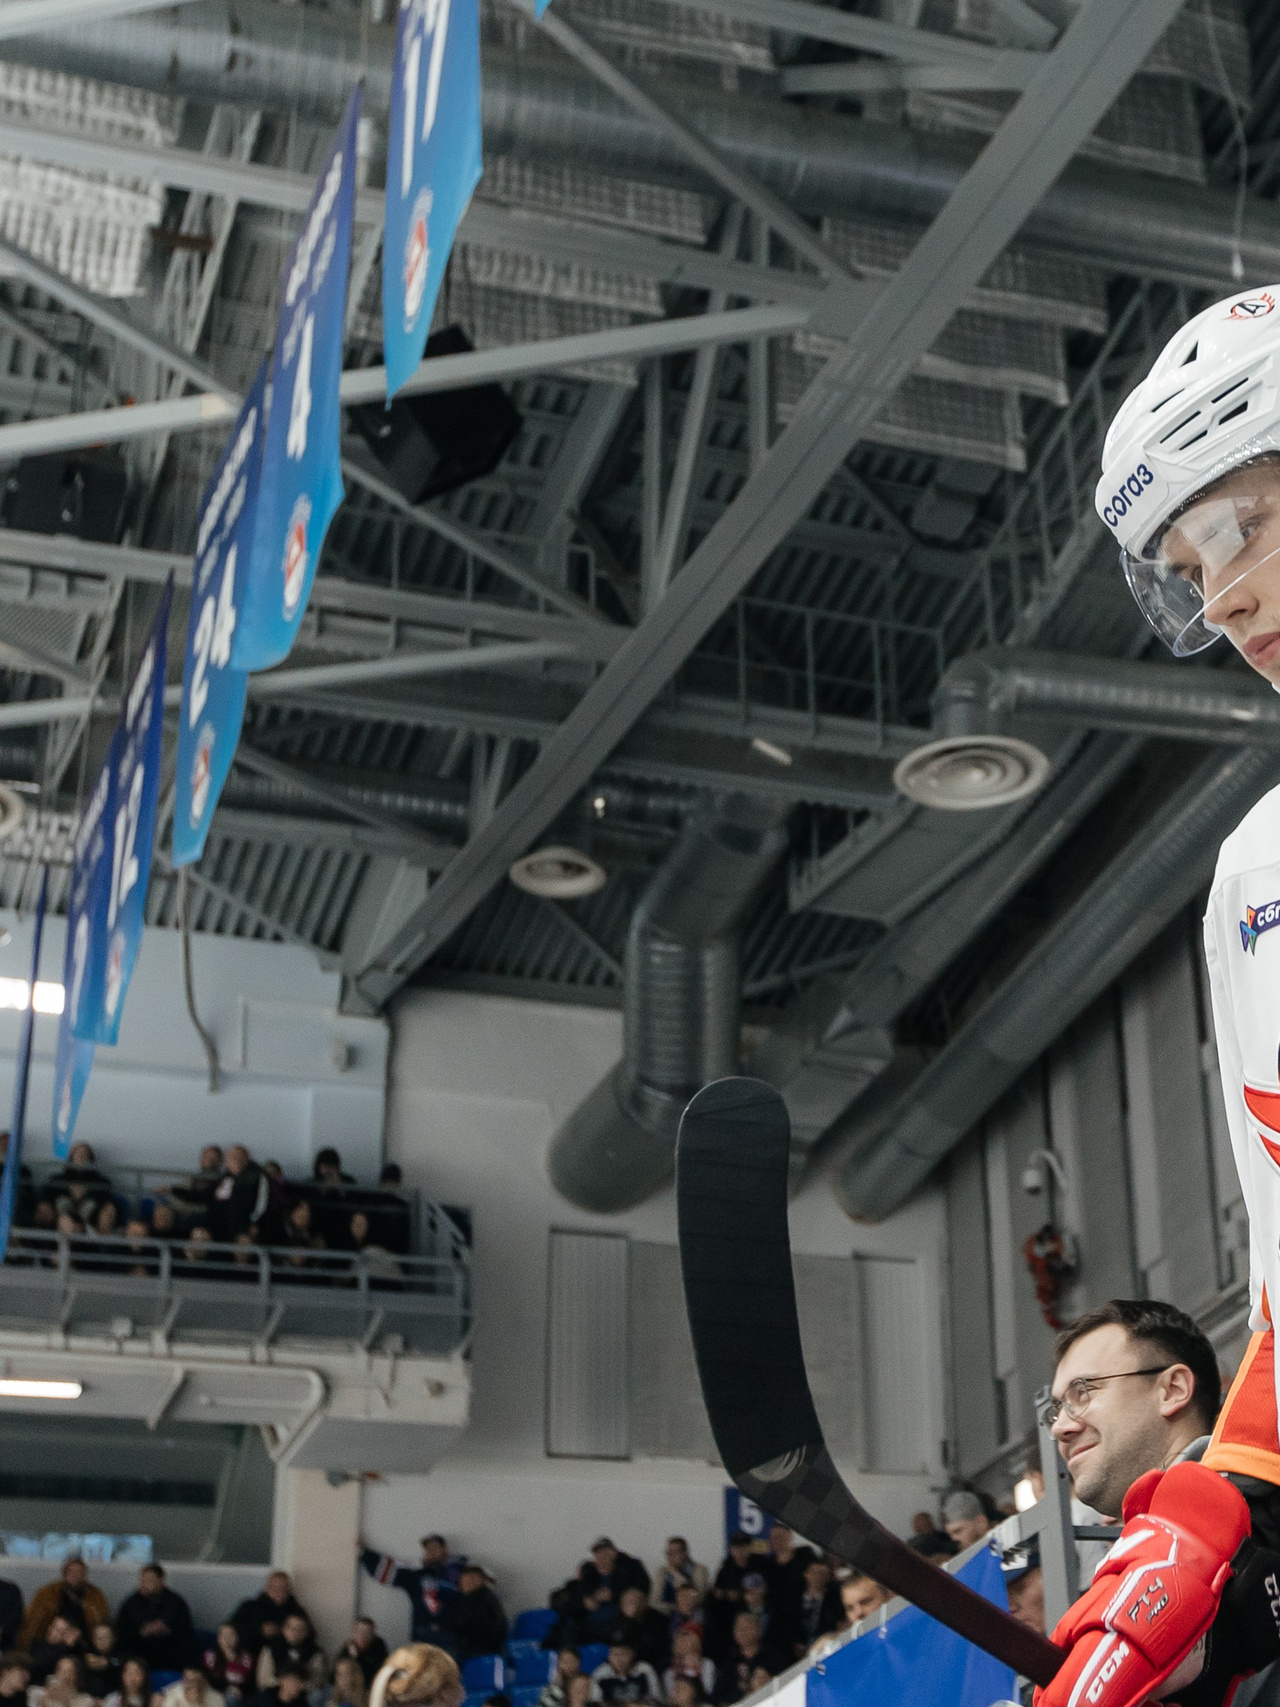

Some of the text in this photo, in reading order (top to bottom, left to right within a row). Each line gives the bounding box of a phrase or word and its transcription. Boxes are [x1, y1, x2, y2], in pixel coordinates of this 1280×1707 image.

[189, 545, 237, 730] 24
[739, 1495, 764, 1535] 5
[1084, 1640, 1130, 1704] CCM
